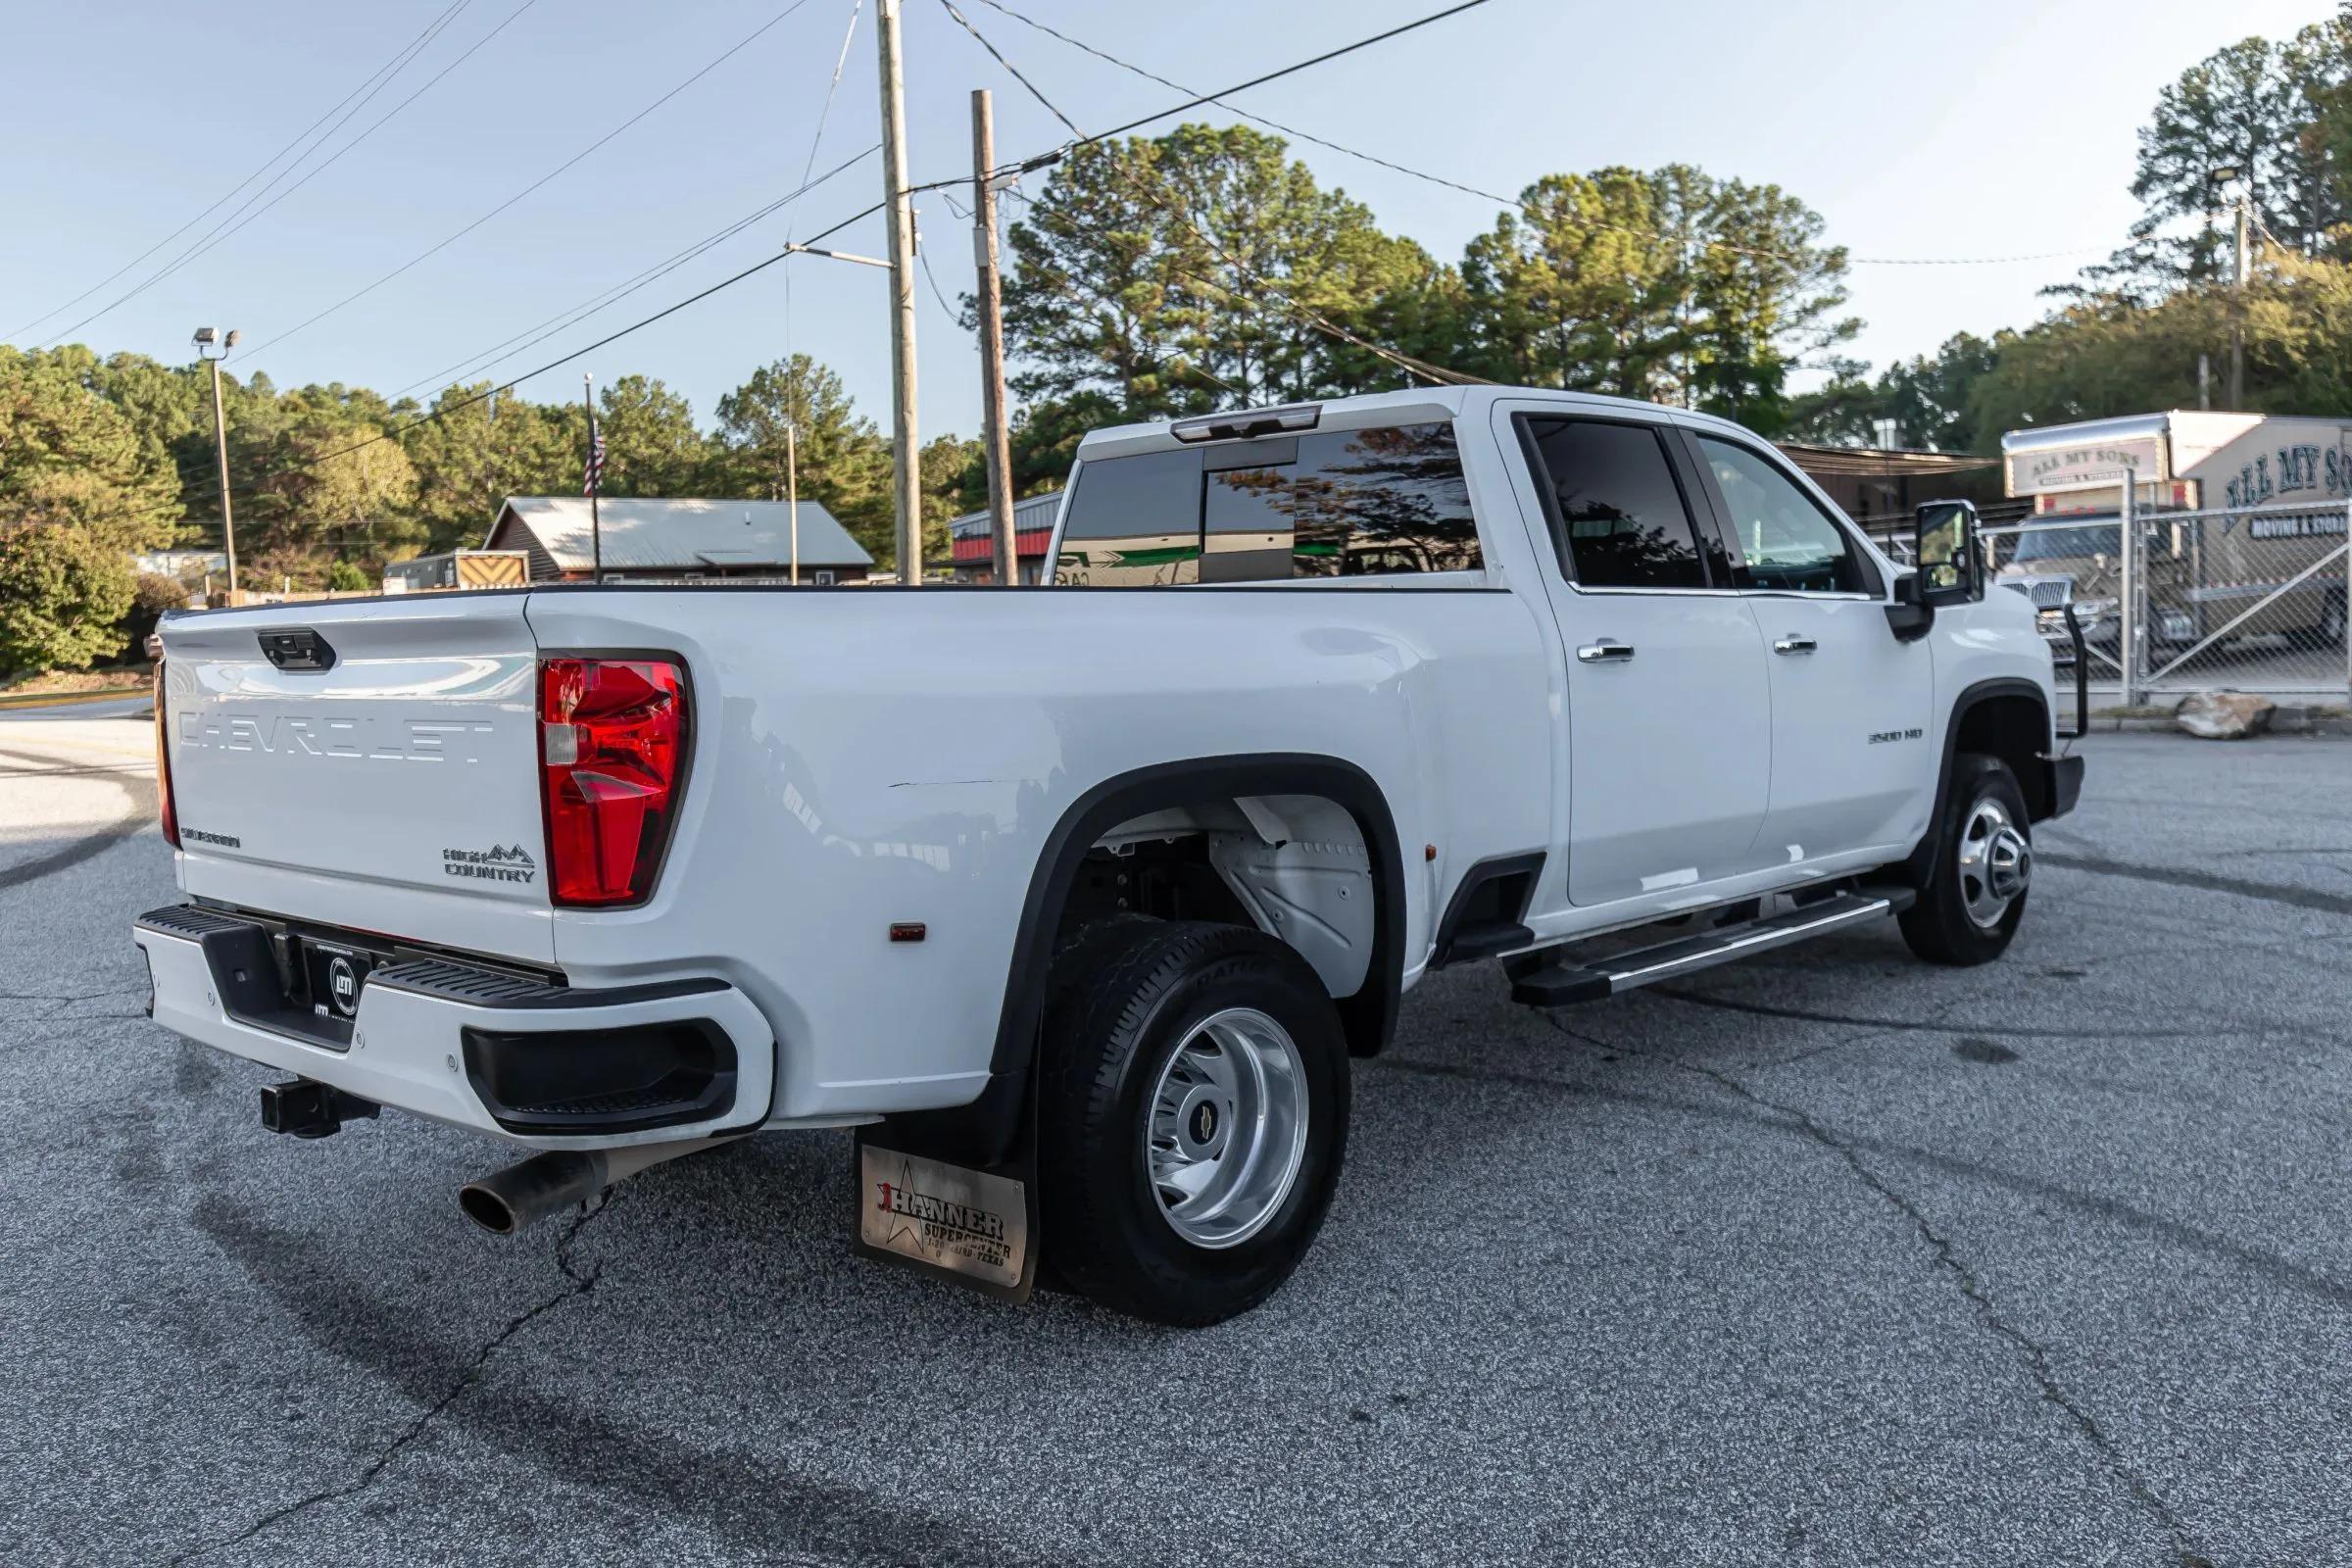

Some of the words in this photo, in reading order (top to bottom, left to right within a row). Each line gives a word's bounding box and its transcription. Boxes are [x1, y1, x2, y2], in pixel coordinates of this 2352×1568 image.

[2277, 442, 2321, 494] MY
[443, 848, 489, 863] HIGH
[444, 863, 535, 884] COUNTRY
[977, 1250, 1004, 1267] TEXAS
